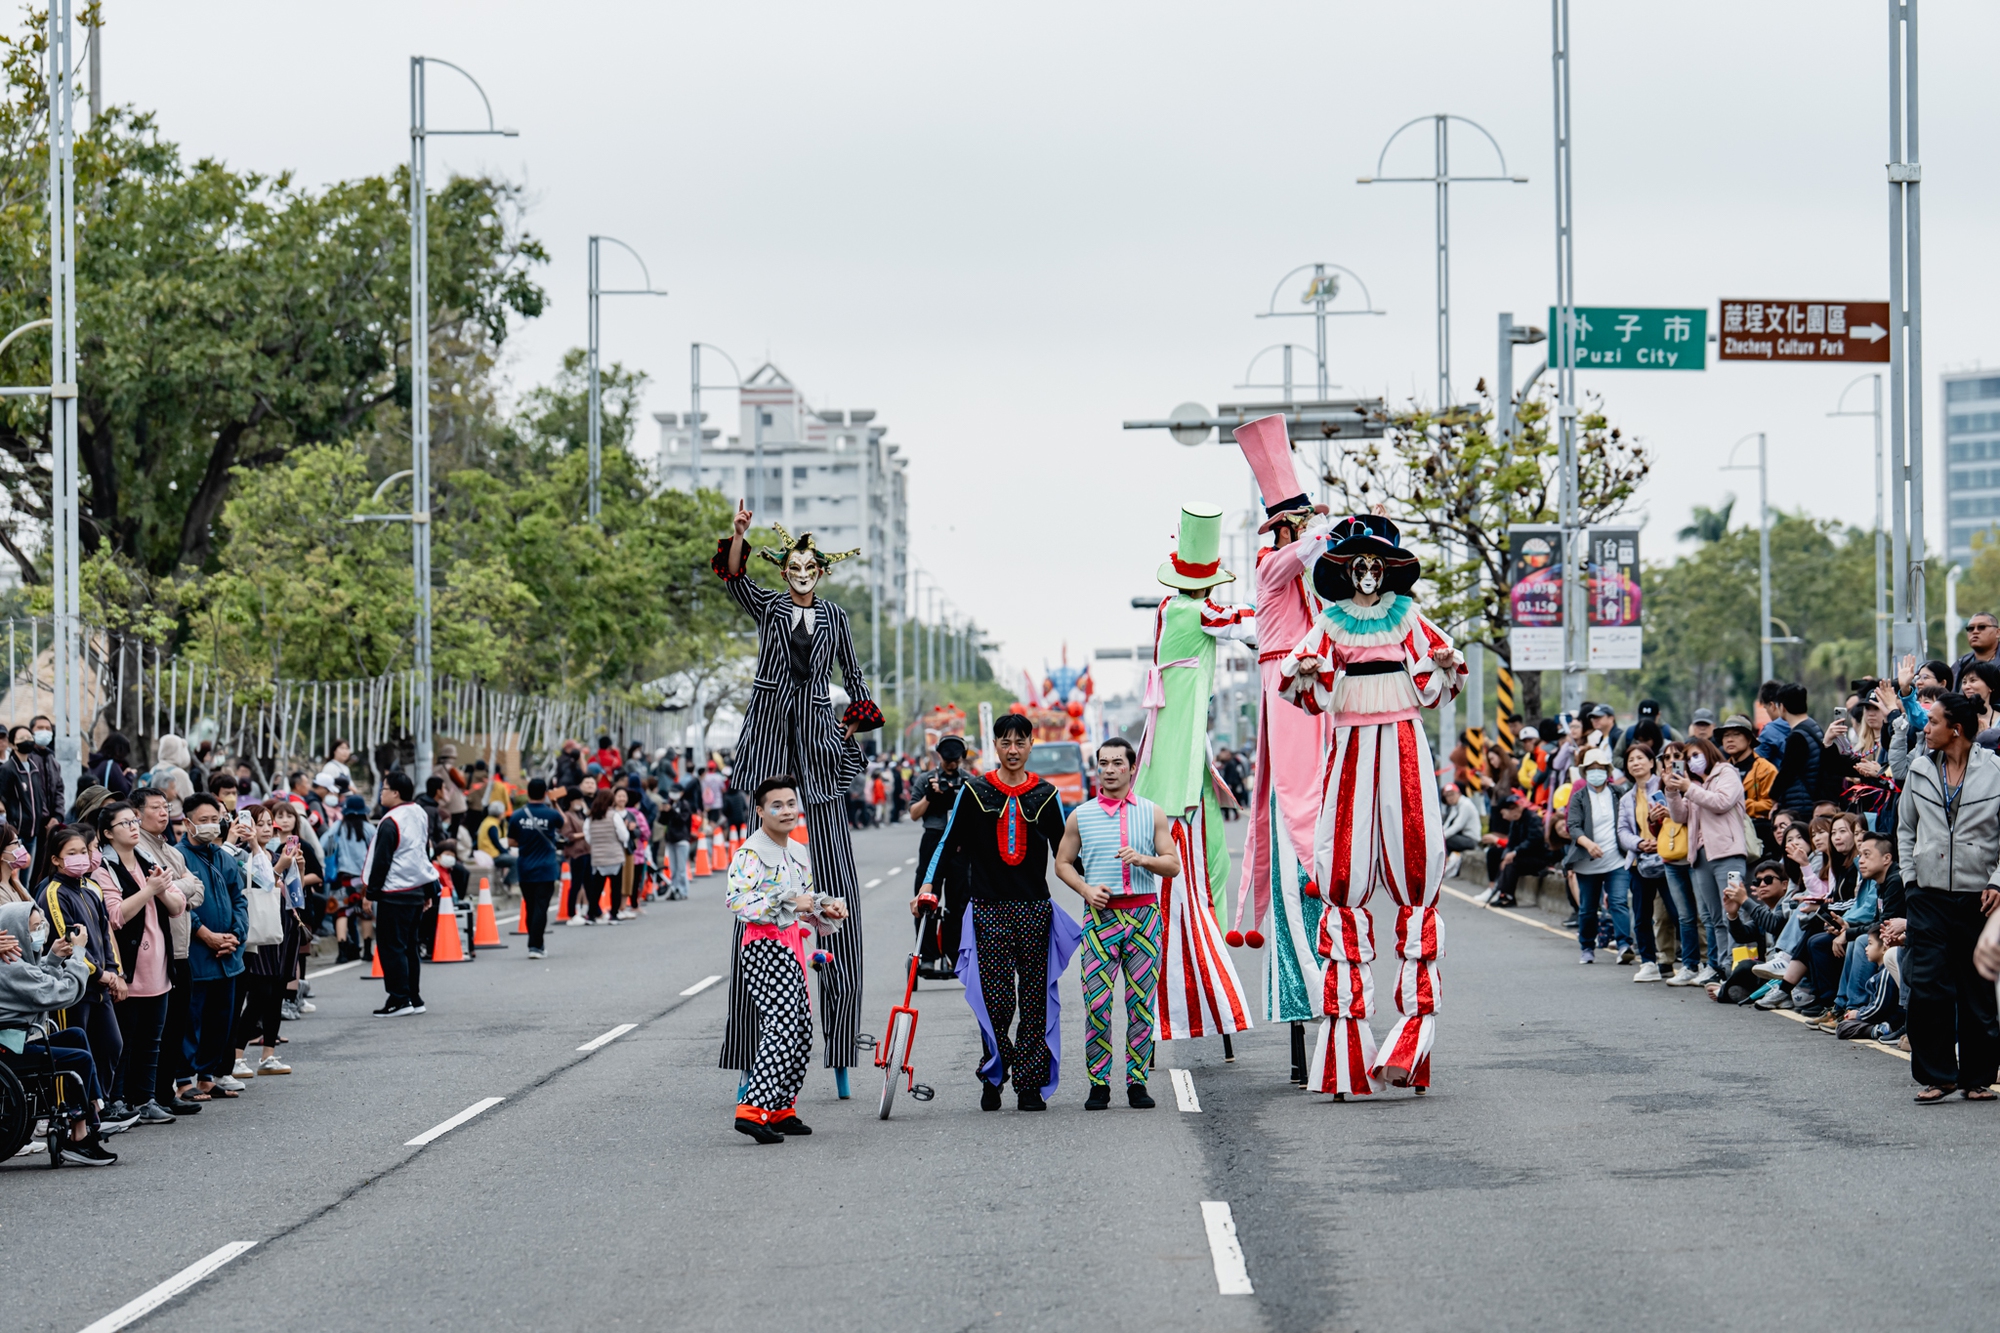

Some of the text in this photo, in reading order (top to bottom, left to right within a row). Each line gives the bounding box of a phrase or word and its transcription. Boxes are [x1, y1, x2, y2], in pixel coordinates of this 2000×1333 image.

[1723, 303, 1847, 334] 蔗埕文化園區
[1575, 347, 1679, 367] Puzi City
[1724, 337, 1844, 359] Zhecheng Culture Park
